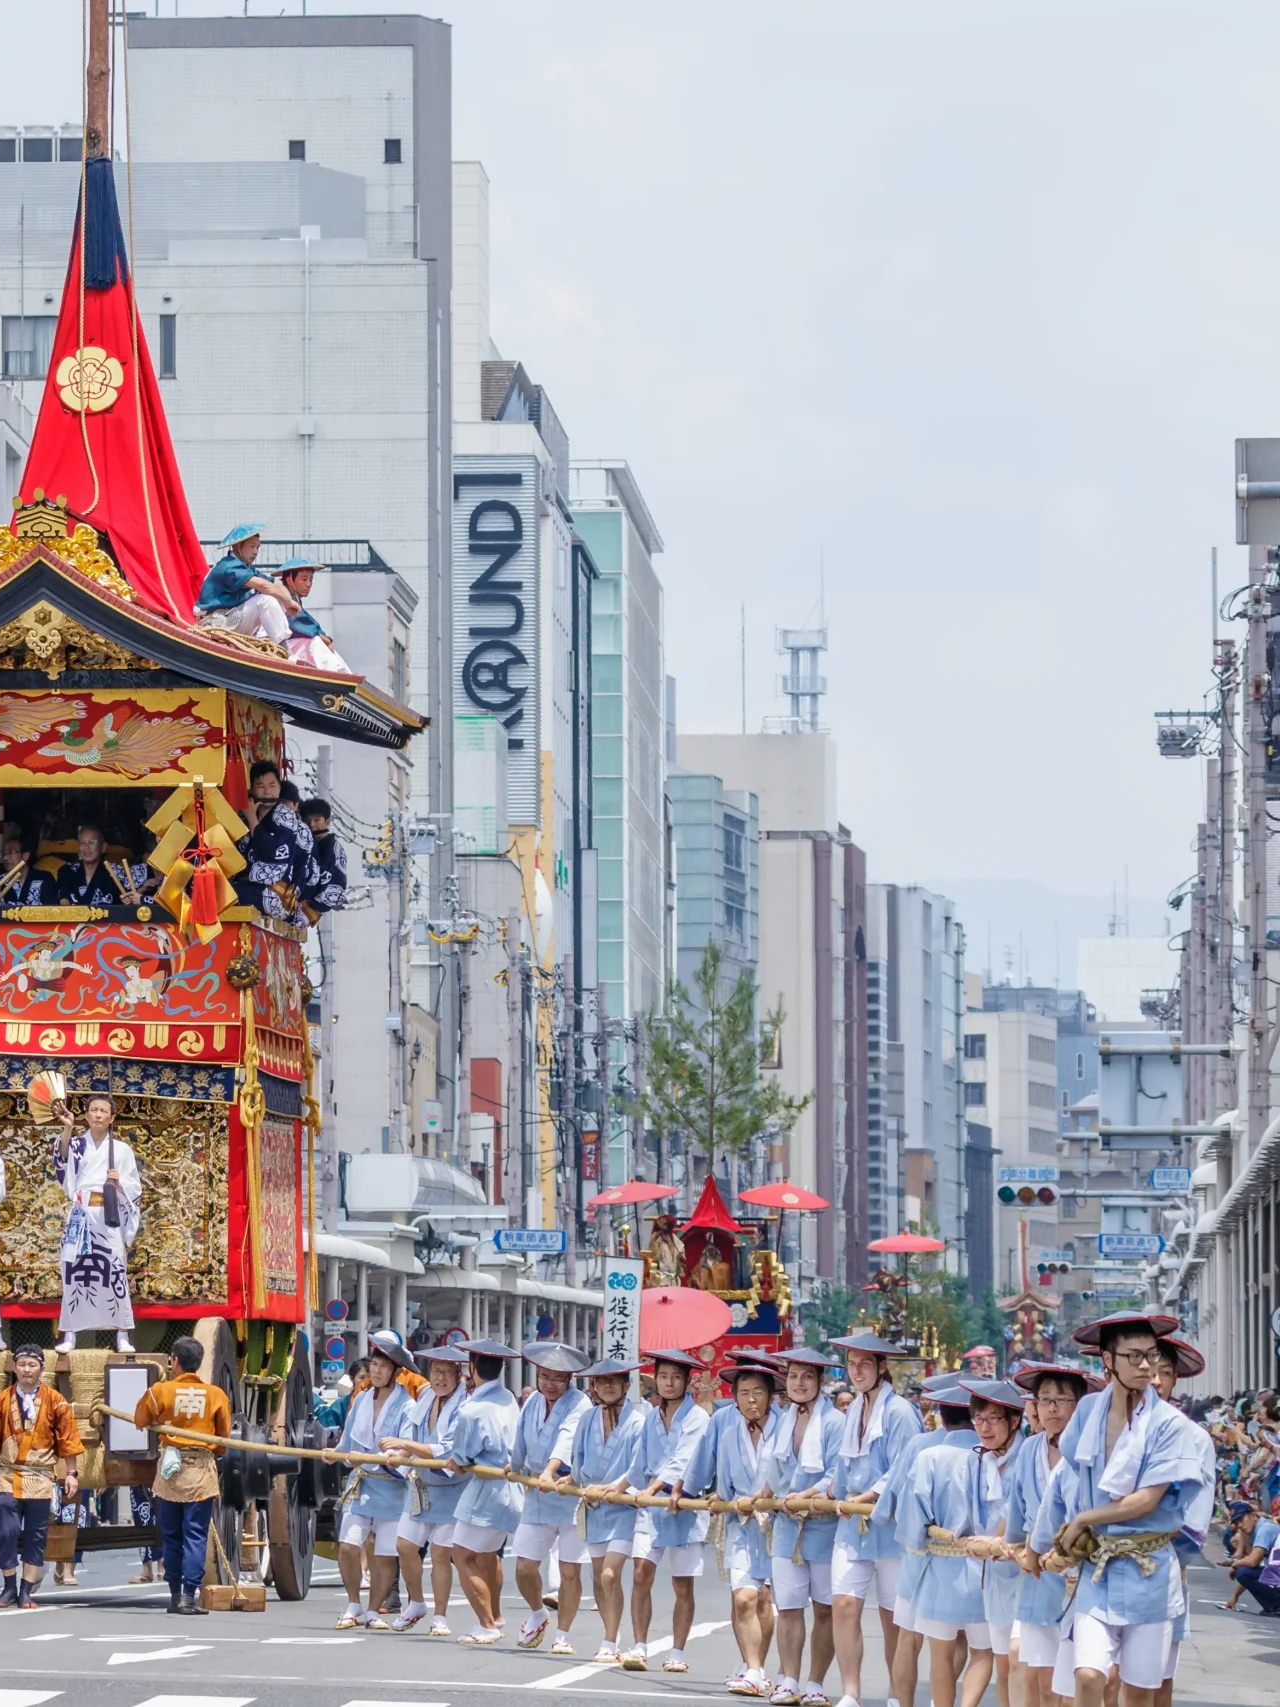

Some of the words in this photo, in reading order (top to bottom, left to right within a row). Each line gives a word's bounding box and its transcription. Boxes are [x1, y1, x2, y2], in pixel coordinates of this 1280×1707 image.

[607, 1296, 631, 1361] 役行者
[174, 1386, 207, 1419] 南
